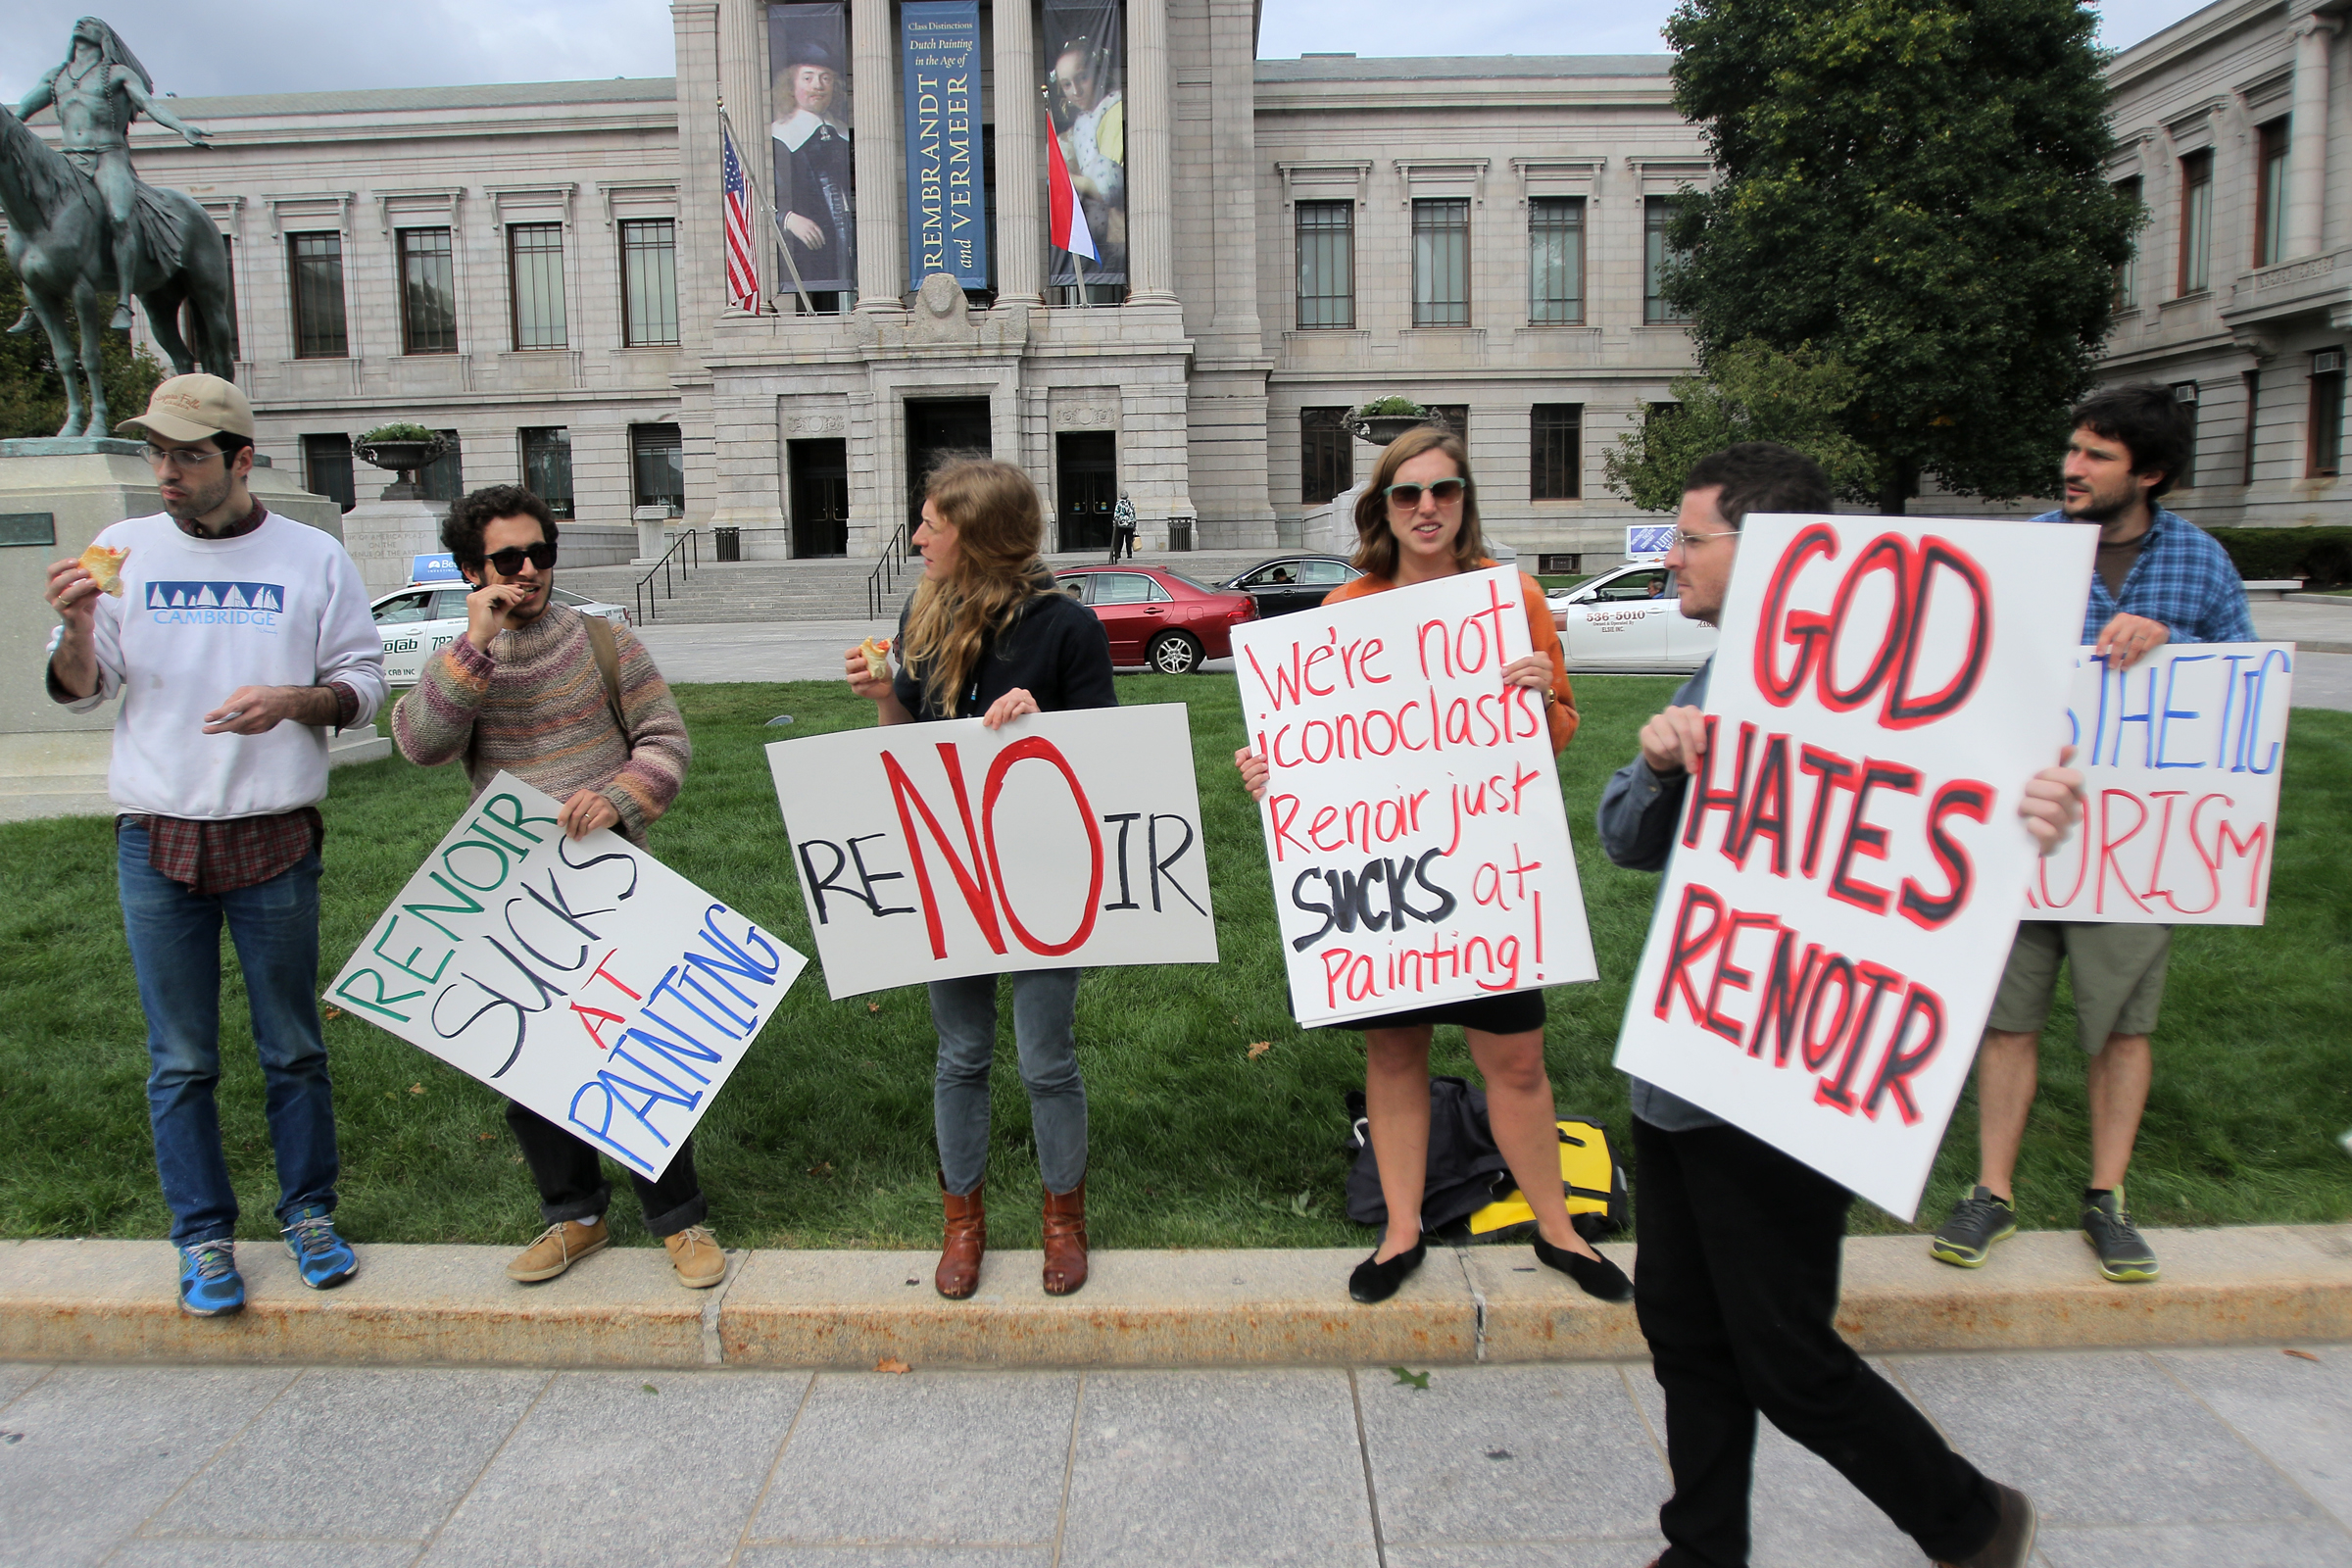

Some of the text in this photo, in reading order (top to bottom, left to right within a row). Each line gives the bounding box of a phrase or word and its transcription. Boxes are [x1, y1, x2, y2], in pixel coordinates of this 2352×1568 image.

[907, 22, 973, 30] Class Distinctions
[910, 38, 973, 51] Dutch Painting
[915, 53, 968, 69] in the Age of
[917, 74, 944, 270] REMBRANDT
[948, 74, 972, 269] and VERMEER
[153, 610, 276, 626] CAMBRIDGE
[1245, 578, 1517, 710] We're not
[1587, 610, 1645, 622] 536-5010
[1752, 521, 1995, 731] GOD
[1257, 684, 1541, 776] iconoclasts
[2067, 649, 2292, 775] THETIC
[1440, 760, 1542, 857] just
[1682, 712, 1999, 931] HATES
[2028, 788, 2269, 915] ORISM
[334, 792, 559, 1023] RENOIR
[431, 833, 637, 1079] SUCKS
[1292, 843, 1543, 953] SUCKS at
[568, 903, 780, 1174] PAINTING
[569, 947, 642, 1051] AT
[1654, 882, 1949, 1127] RENOIR
